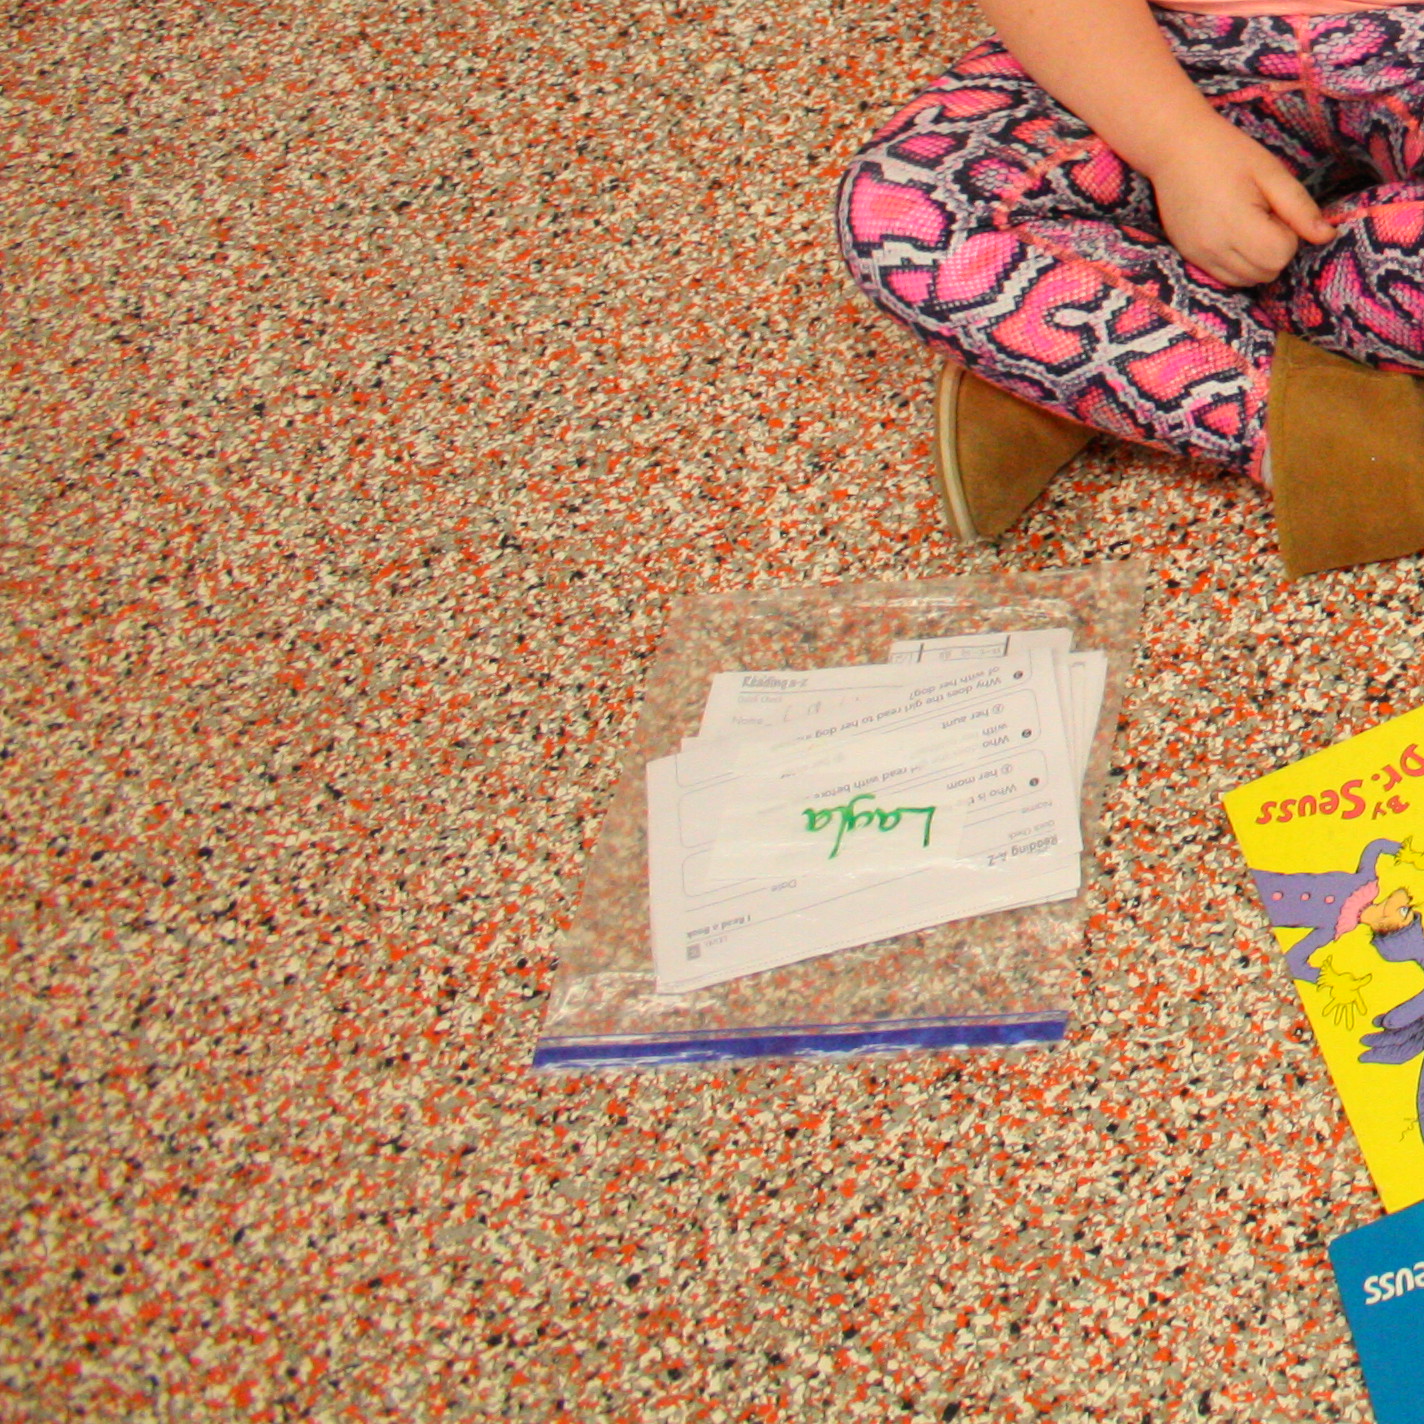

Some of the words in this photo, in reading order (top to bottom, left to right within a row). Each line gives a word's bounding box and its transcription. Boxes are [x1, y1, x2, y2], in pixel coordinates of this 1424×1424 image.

[959, 670, 985, 682] with
[987, 666, 1000, 675] of
[939, 679, 957, 689] her
[976, 676, 1002, 689] Why
[908, 685, 936, 699] dog?
[946, 685, 973, 698] does
[904, 699, 923, 712] girl
[926, 693, 945, 705] the
[861, 715, 873, 724] to
[876, 707, 901, 720] read
[970, 709, 989, 720] her
[840, 719, 859, 730] her
[941, 715, 967, 730] aunt
[815, 725, 837, 738] dog
[982, 723, 1008, 736] with
[982, 735, 1010, 748] Who
[881, 767, 907, 782] read
[978, 769, 998, 781] her
[853, 775, 879, 788] with
[946, 776, 976, 790] mom
[978, 792, 986, 802] is
[989, 784, 1016, 797] Who
[1255, 779, 1366, 825] Seuss
[1371, 795, 1410, 820] By
[801, 794, 936, 860] Layla
[1011, 835, 1058, 856] Reading
